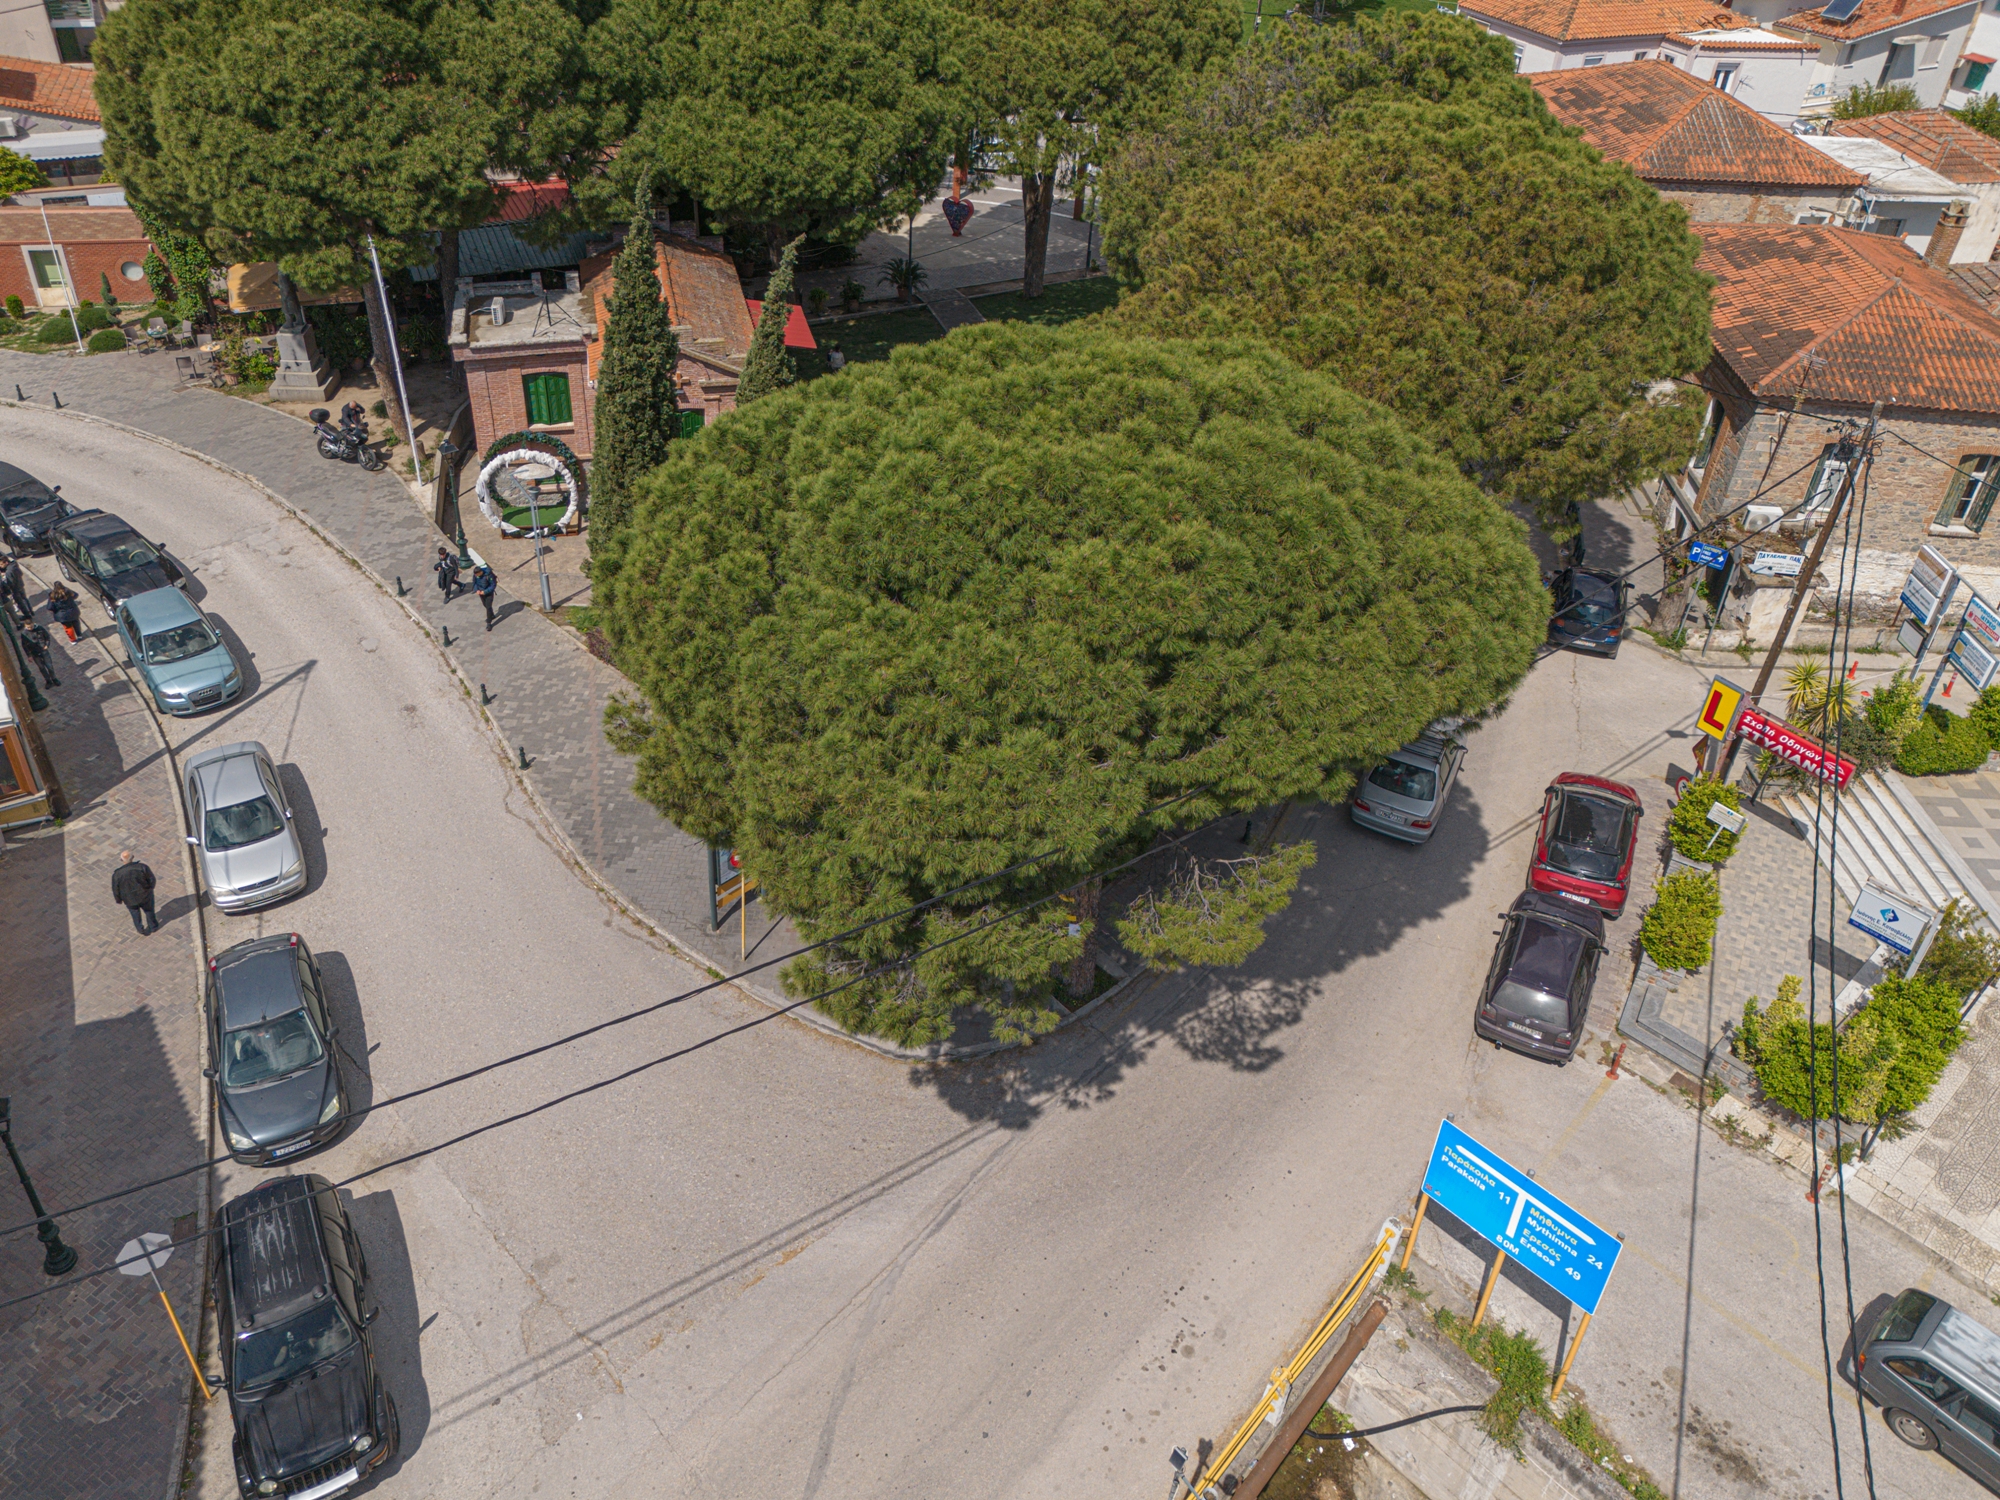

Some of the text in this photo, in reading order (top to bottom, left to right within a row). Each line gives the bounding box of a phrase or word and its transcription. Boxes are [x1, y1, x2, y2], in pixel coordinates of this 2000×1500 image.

[1691, 546, 1701, 555] P
[1703, 689, 1724, 731] L
[1739, 725, 1843, 784] ΣΤΥΛΙΑΝΟΣ
[1743, 715, 1822, 760] Σχολή Οδηγών
[1856, 908, 1876, 924] Ιωάννης
[1441, 1155, 1511, 1205] Parakoila 11
[1444, 1145, 1496, 1188] Παράκοιλα
[1523, 1228, 1562, 1262] Ερεσός
[1526, 1216, 1603, 1270] Mythimna 24
[1530, 1207, 1578, 1246] Μήθυμνα
[1519, 1237, 1581, 1281] Eresos 49
